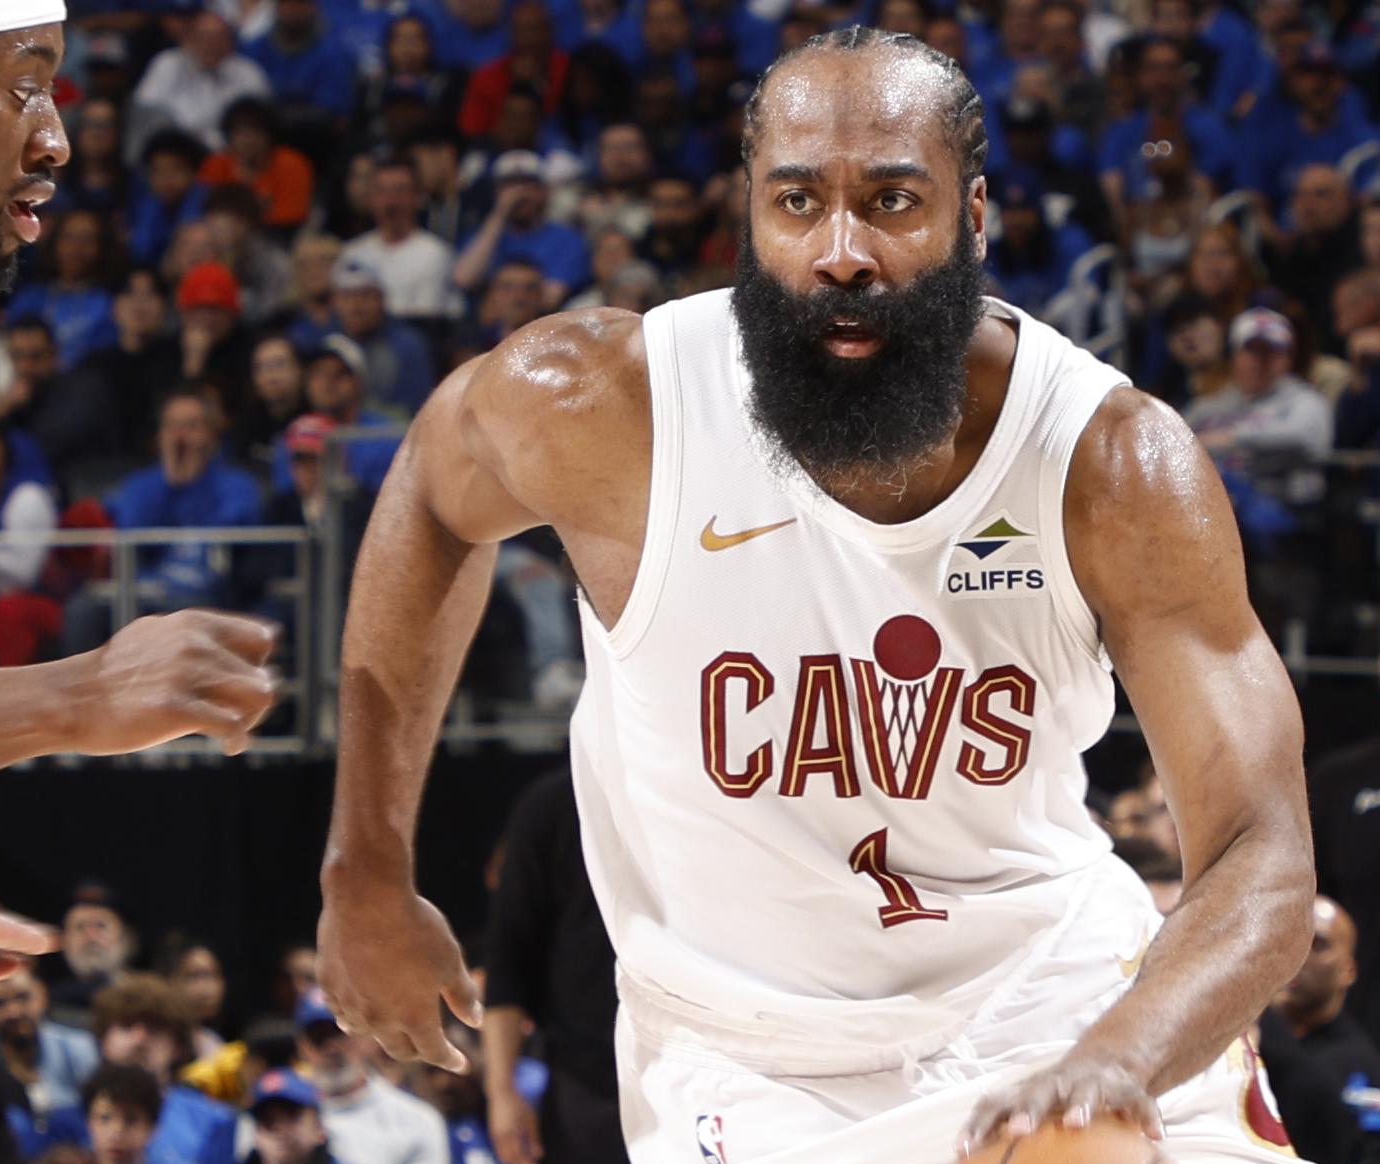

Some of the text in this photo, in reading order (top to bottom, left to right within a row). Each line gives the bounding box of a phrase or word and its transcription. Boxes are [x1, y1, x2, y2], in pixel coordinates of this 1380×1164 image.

[947, 569, 1044, 593] CLIFFS
[700, 650, 1037, 800] CAVS
[848, 826, 949, 929] 1
